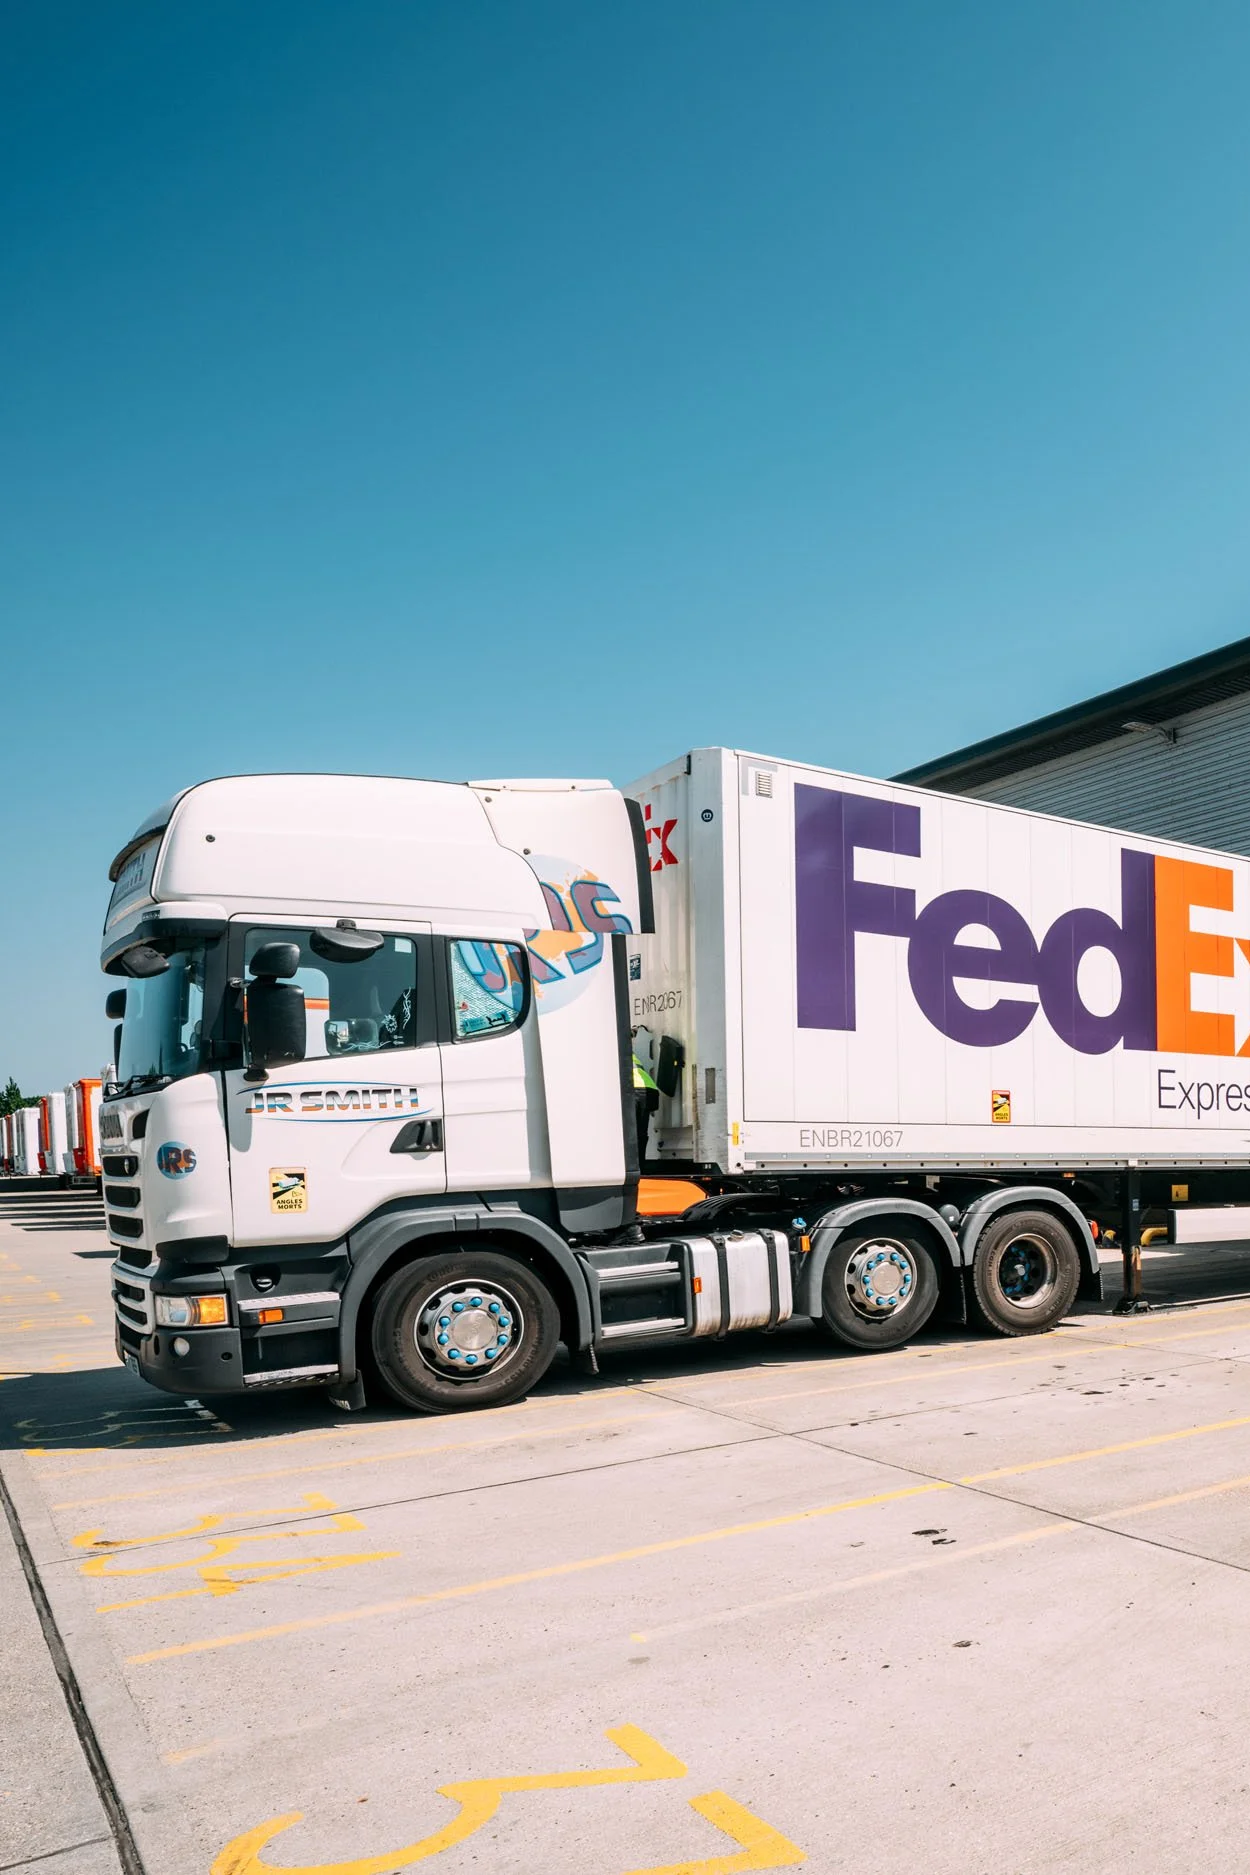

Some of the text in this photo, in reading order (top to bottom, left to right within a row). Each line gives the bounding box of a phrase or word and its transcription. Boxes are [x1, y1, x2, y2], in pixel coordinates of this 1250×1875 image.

[244, 1087, 419, 1114] JR SMITH
[799, 1129, 904, 1148] ENBR21067
